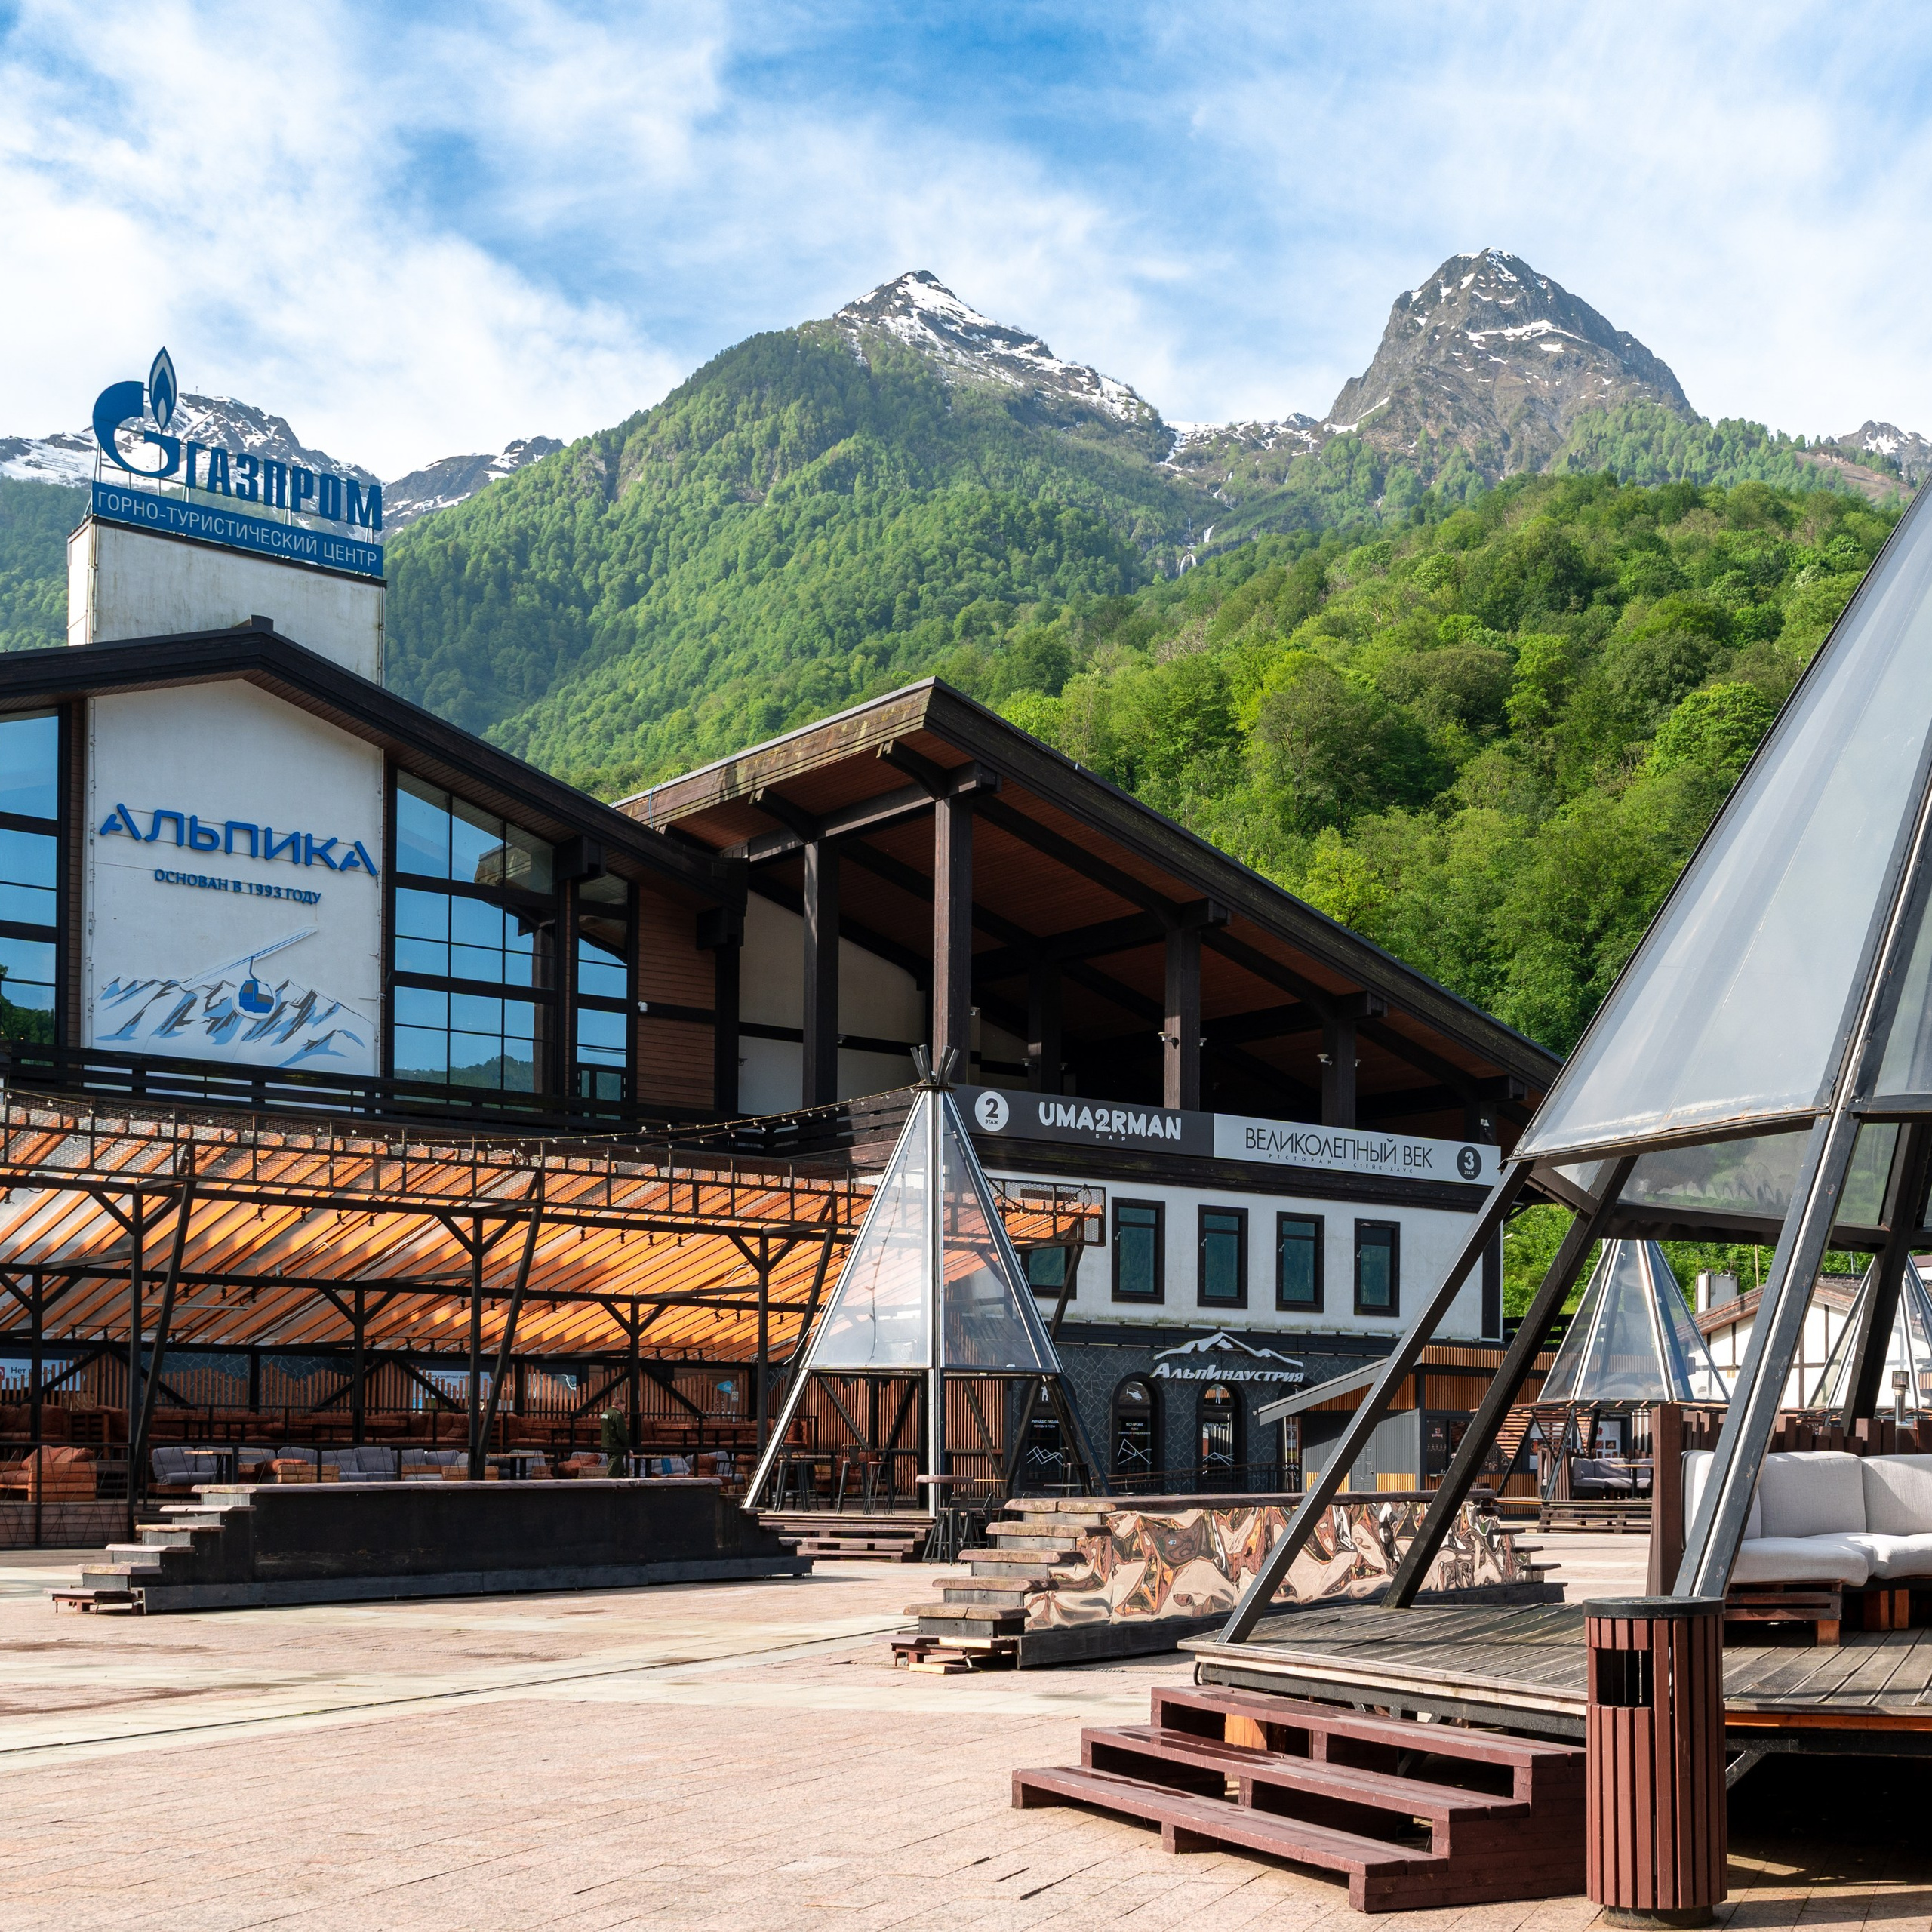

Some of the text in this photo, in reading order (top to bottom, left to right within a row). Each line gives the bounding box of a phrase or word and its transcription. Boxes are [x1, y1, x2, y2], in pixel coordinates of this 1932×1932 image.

[186, 441, 383, 531] ГАЗПРОМ
[97, 491, 377, 567] ГОРНО-ТУРИСТИЧЕСКИЙ ЦЕНТР
[100, 803, 377, 876] АЛЬПИКА
[154, 869, 321, 905] ОСНОВАН В 1993 ГОДУ
[985, 1097, 998, 1118] 2
[1038, 1101, 1181, 1140] UMA2RMAN
[1095, 1134, 1126, 1142] БАР
[1246, 1127, 1433, 1168] ВЕЛИКОЛЕПНЫЙ ВЕК
[1269, 1153, 1332, 1164] РЕСТОРАН
[1464, 1151, 1475, 1169] 3
